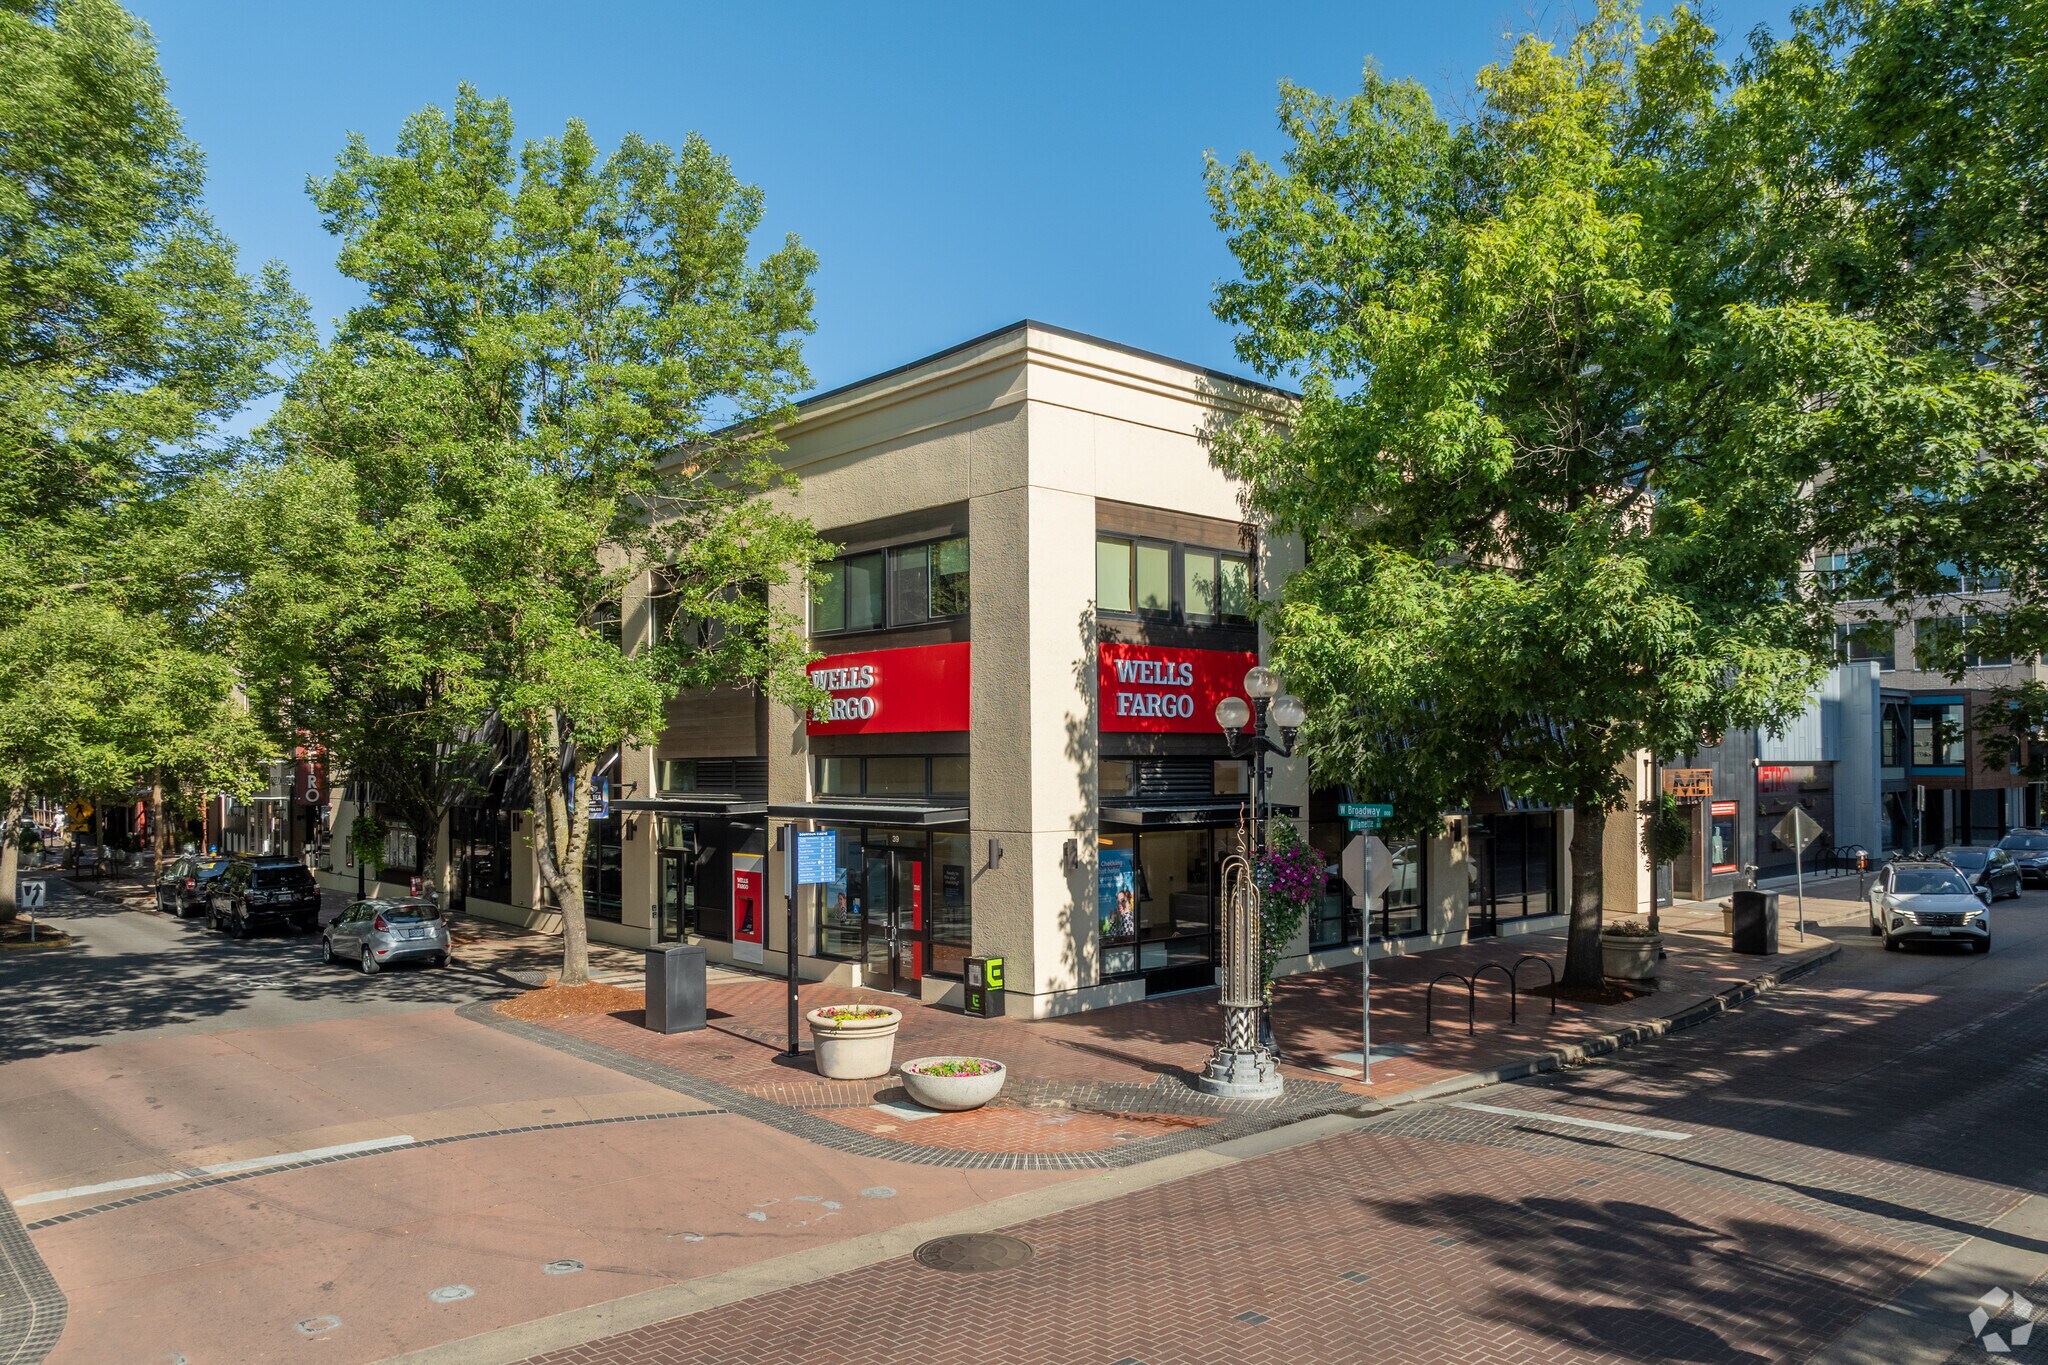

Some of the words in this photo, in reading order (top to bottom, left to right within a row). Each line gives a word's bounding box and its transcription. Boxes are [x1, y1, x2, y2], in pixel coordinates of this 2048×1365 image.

[810, 665, 874, 690] WELLS
[1114, 659, 1193, 686] WELLS
[1116, 692, 1194, 718] FARGO
[1340, 805, 1346, 814] W
[1348, 805, 1380, 816] Broadway
